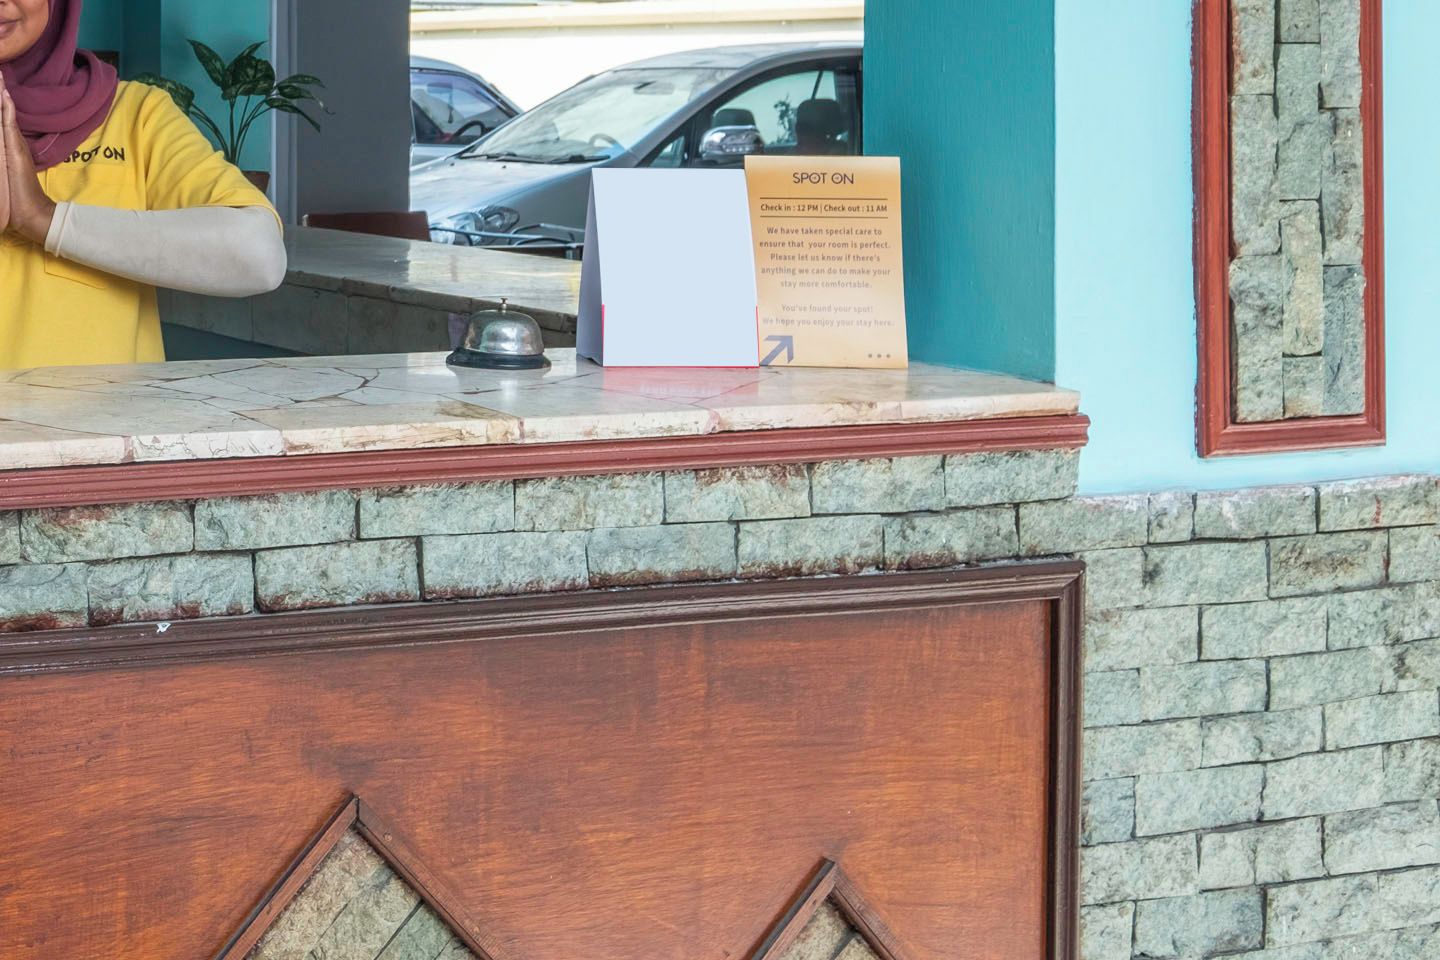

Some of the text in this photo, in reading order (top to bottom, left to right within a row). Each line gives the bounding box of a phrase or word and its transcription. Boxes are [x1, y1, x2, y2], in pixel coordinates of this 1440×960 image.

[103, 146, 126, 161] ON
[792, 172, 854, 184] SPOT ON
[760, 203, 782, 212] Check
[825, 228, 853, 236] special
[860, 241, 891, 250] perfect.
[761, 266, 796, 275] anything
[821, 280, 872, 288] comfortable.
